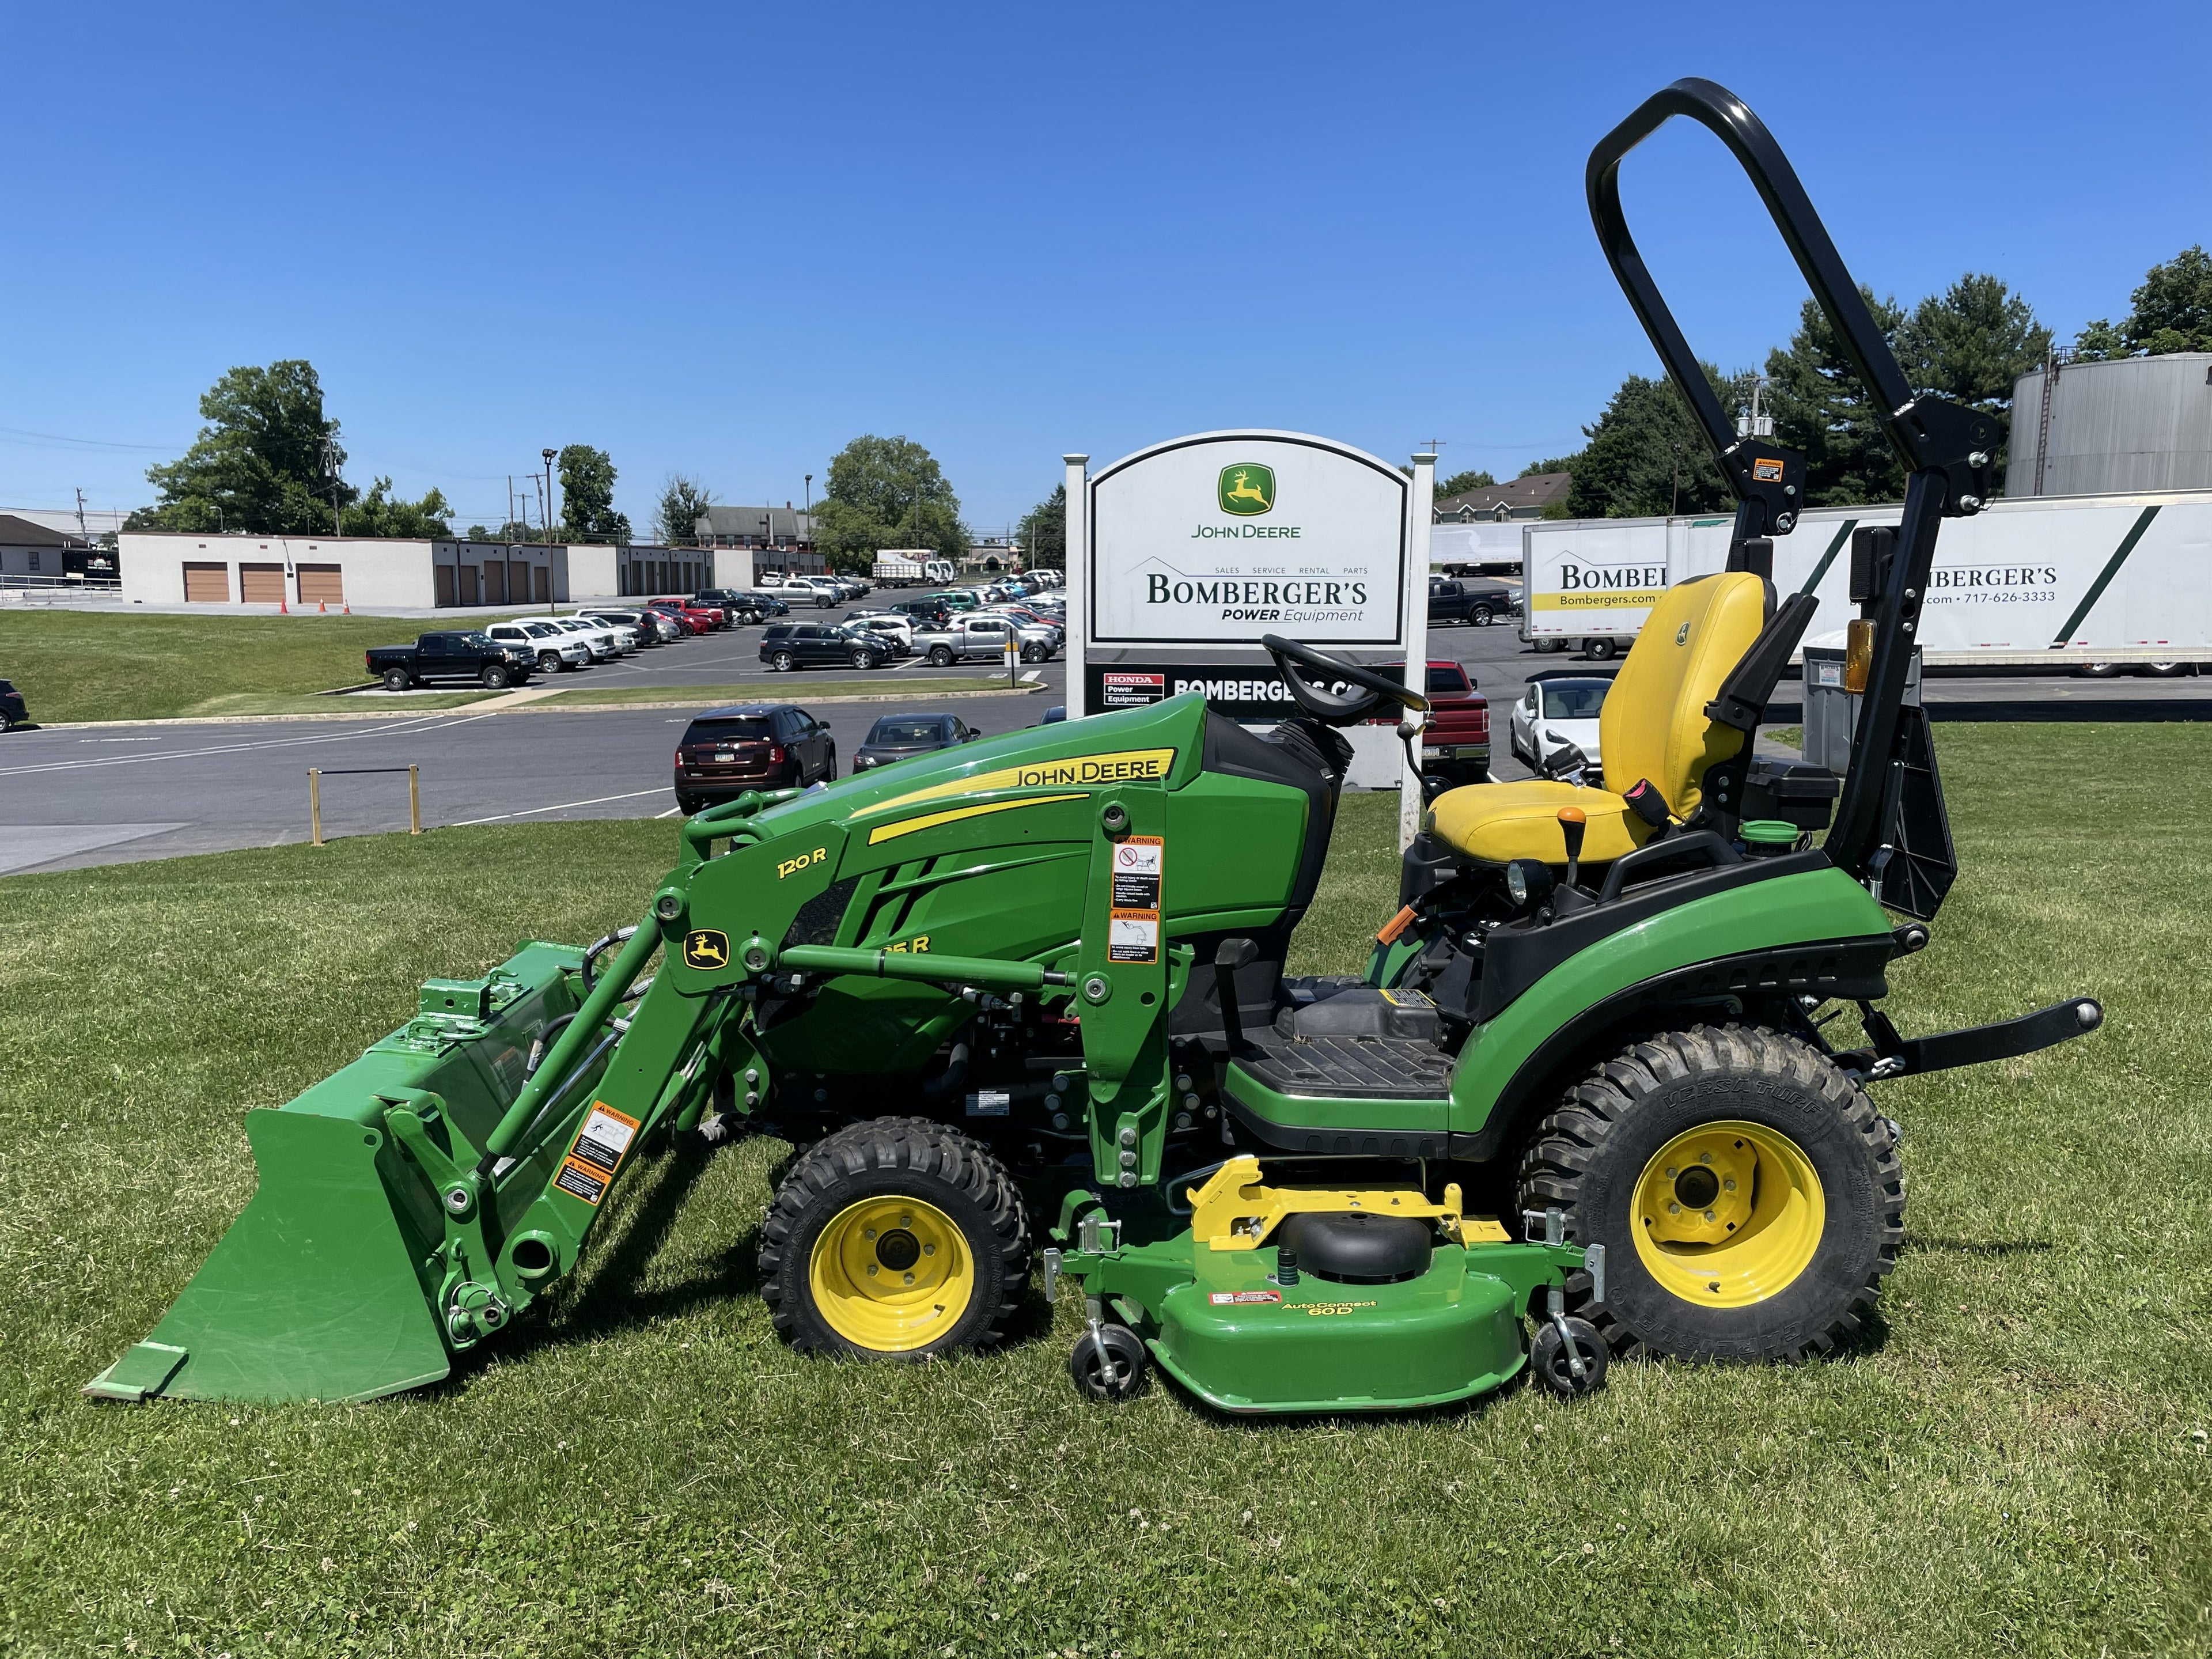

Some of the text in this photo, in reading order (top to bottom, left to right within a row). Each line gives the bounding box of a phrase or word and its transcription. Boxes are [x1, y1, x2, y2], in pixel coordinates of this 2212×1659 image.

[1191, 524, 1301, 538] JOHN DEERE
[1146, 574, 1367, 604] BOMBERGER'S
[1964, 591, 2055, 604] 717-626-3333
[1560, 594, 1656, 607] Bombergers.com
[1221, 609, 1364, 623] POWER Equipment
[1108, 695, 1150, 703] Equipment
[1009, 759, 1159, 787] JOHN DEERE
[777, 847, 827, 880] 120 R
[1120, 912, 1157, 920] WARNING
[1662, 1078, 1823, 1114] VERSA TURF
[606, 1109, 634, 1126] WARNING
[578, 1164, 605, 1181] WARNING
[783, 1198, 825, 1304] CARLISLE
[987, 1244, 1002, 1309] VERSA
[1281, 1301, 1377, 1309] AutoConnect
[1308, 1307, 1354, 1316] 60D
[1635, 1313, 1802, 1354] CARLISLE
